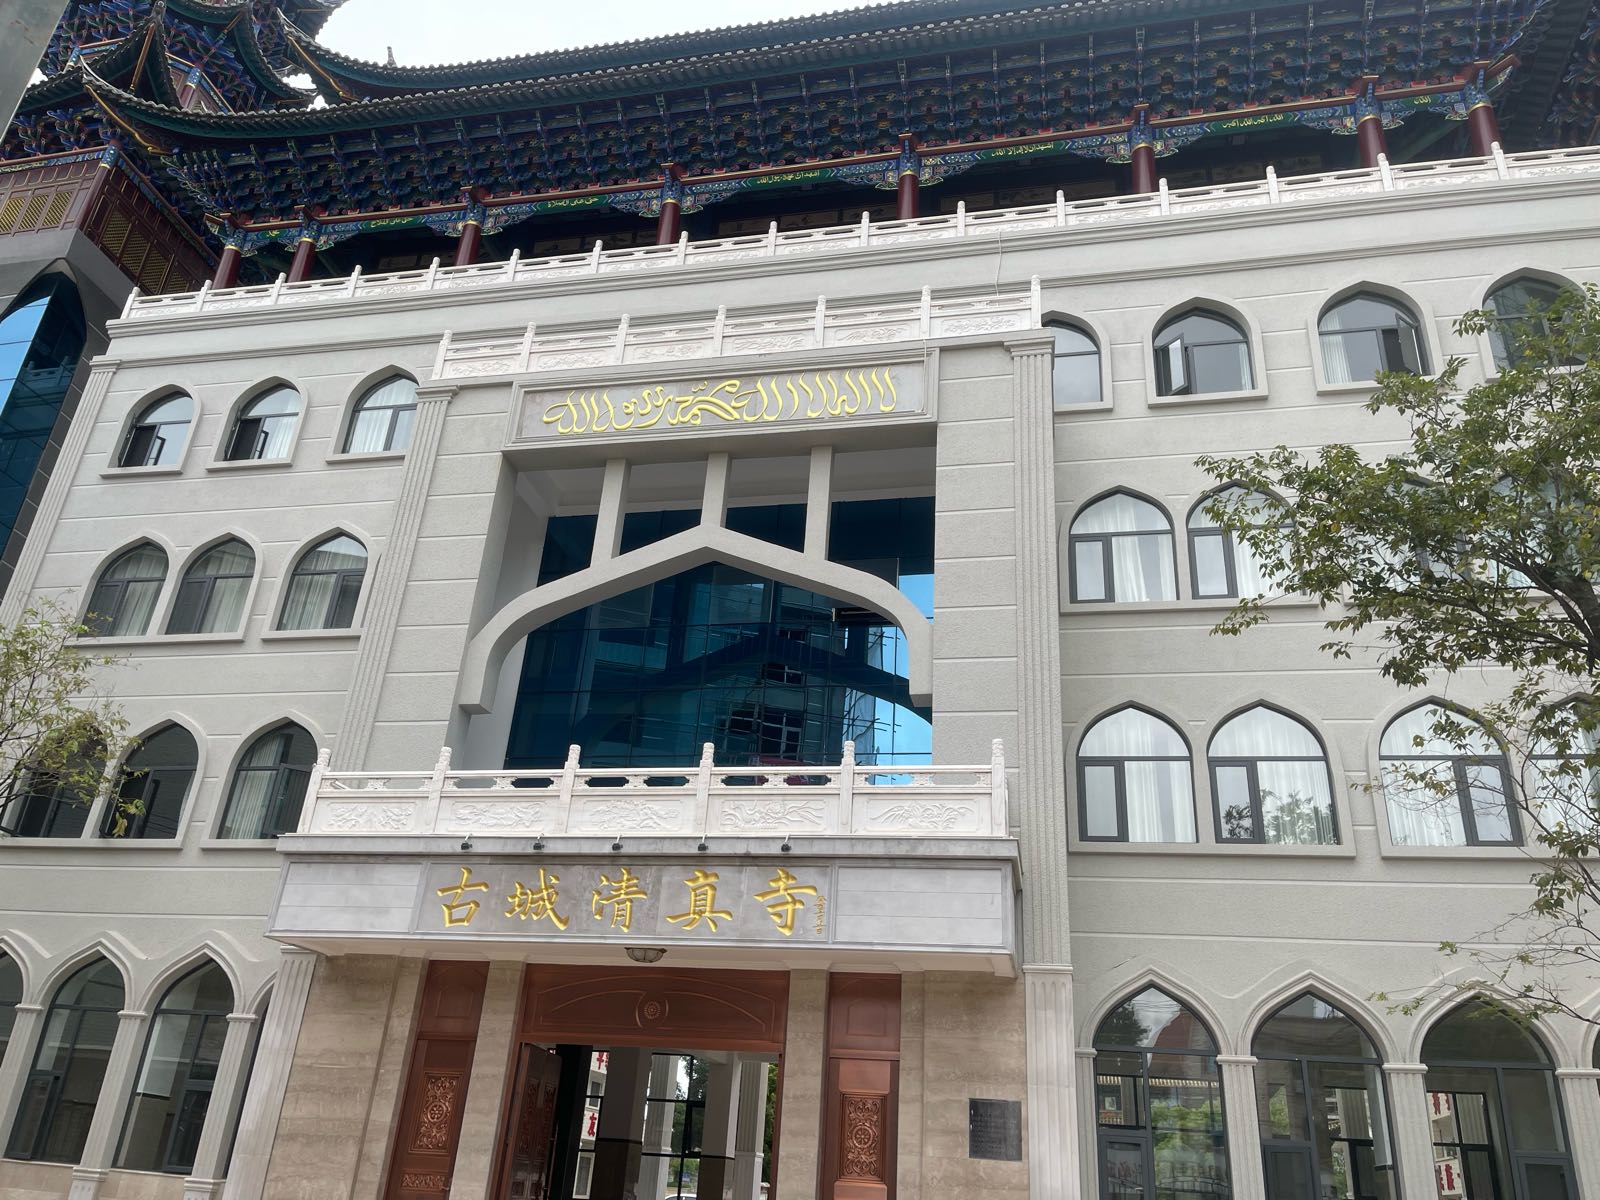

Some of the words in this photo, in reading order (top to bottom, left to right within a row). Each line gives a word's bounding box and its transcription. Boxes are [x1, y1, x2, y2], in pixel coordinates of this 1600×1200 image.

[436, 866, 818, 936] 古城清真寺
